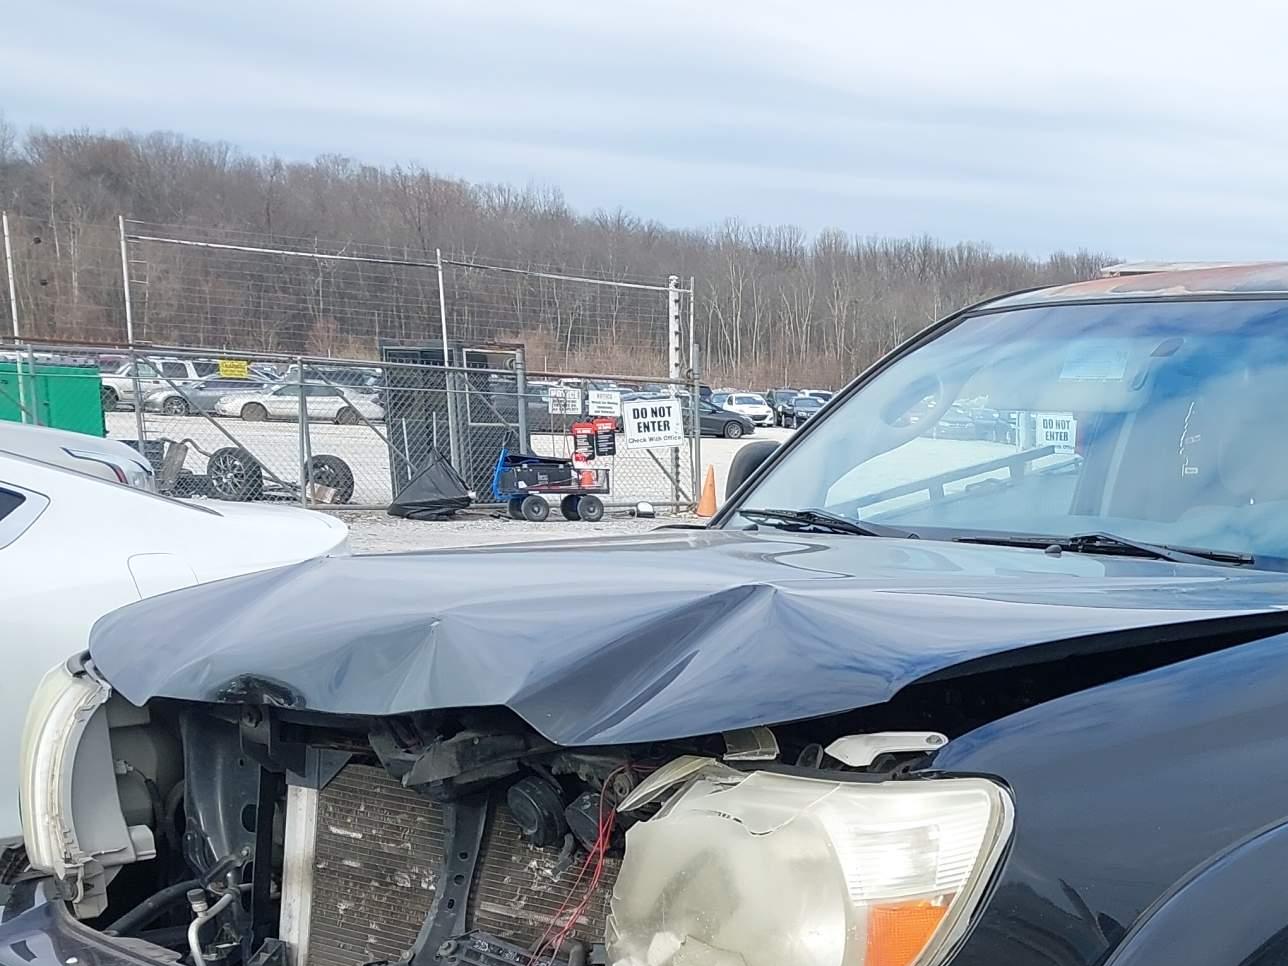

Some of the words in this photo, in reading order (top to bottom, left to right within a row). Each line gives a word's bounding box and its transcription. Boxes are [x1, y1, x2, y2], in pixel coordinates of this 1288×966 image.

[632, 407, 648, 420] DO
[650, 406, 672, 418] NOT
[637, 420, 671, 433] ENTER
[1042, 418, 1054, 430] DO
[1055, 419, 1071, 430] NOT
